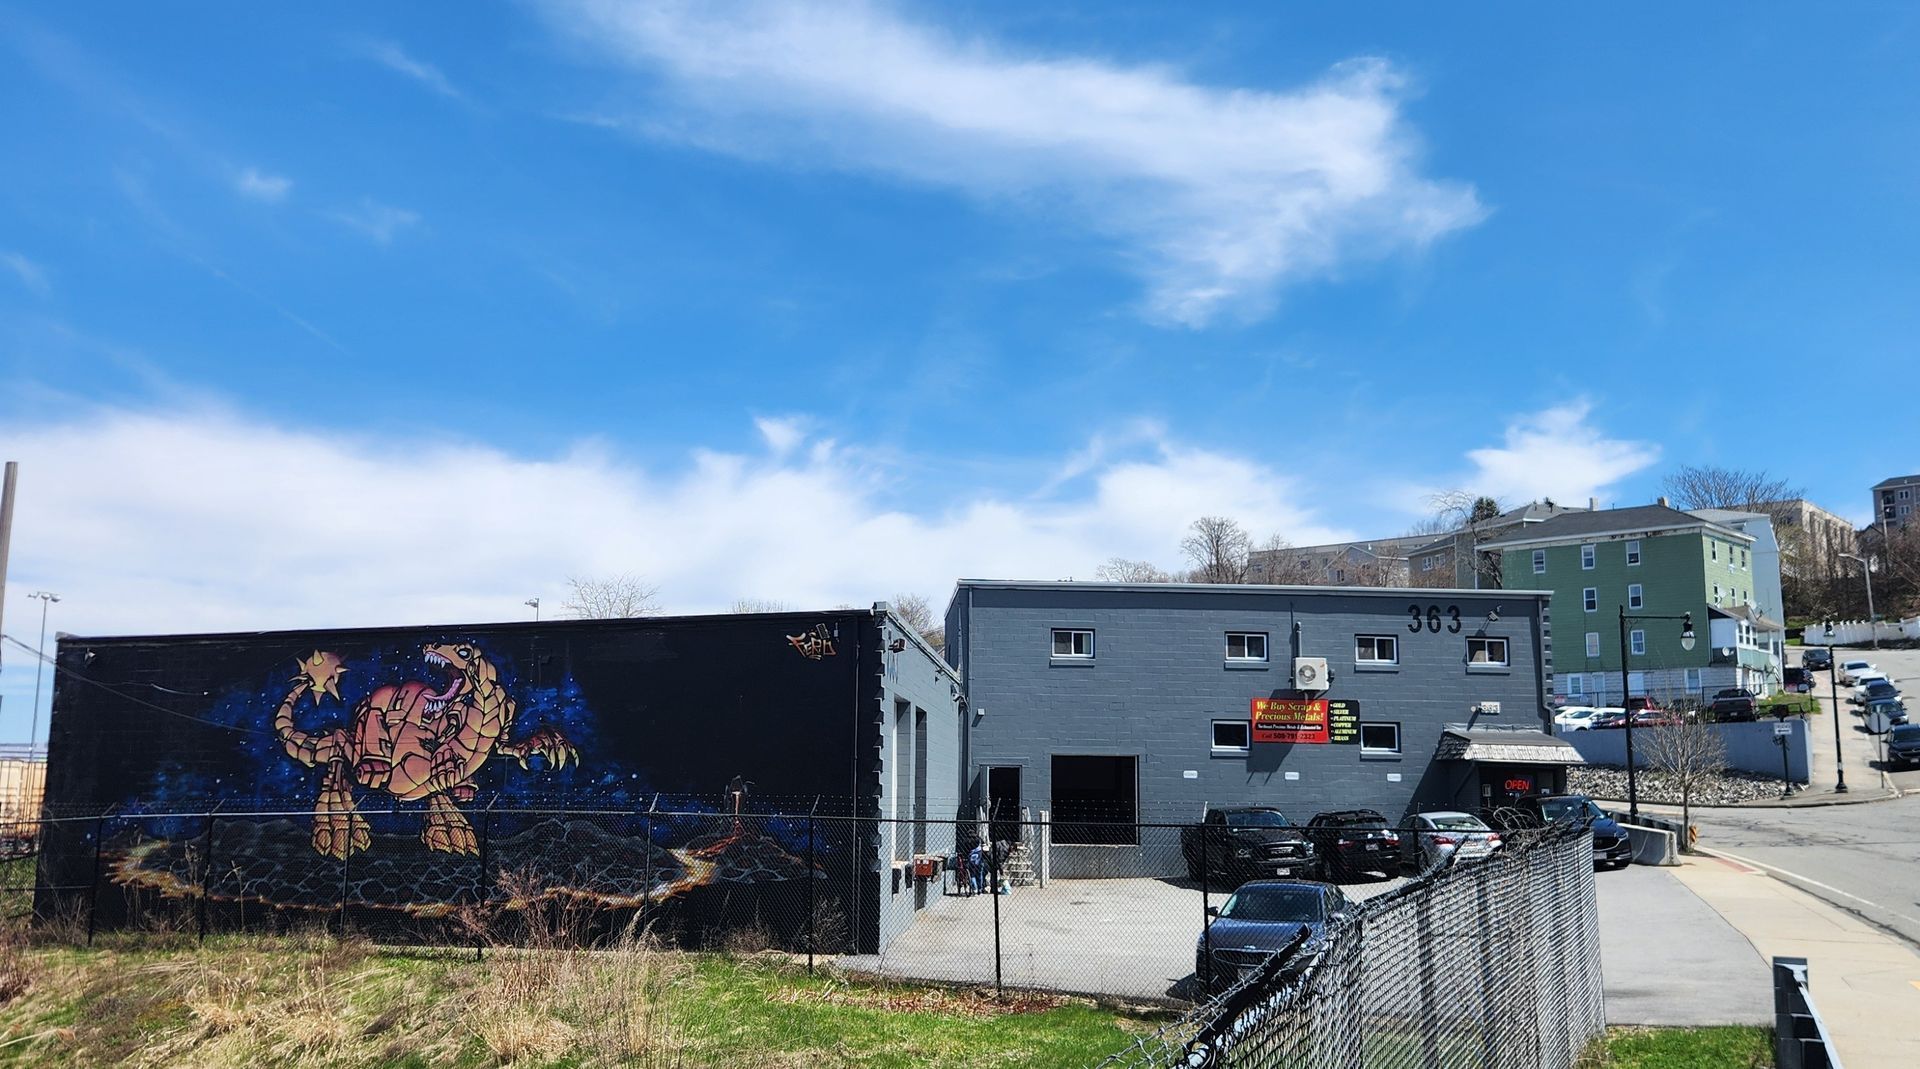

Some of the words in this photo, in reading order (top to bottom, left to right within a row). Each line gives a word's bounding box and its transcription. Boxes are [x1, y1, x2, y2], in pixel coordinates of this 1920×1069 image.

[1407, 604, 1462, 634] 363
[1256, 701, 1269, 710] We
[1270, 702, 1285, 712] Buy
[1287, 702, 1312, 713] Scrap
[1313, 702, 1321, 711] &
[1255, 711, 1292, 720] Precious
[1292, 712, 1324, 721] Metals!
[1504, 779, 1530, 790] OPEN
